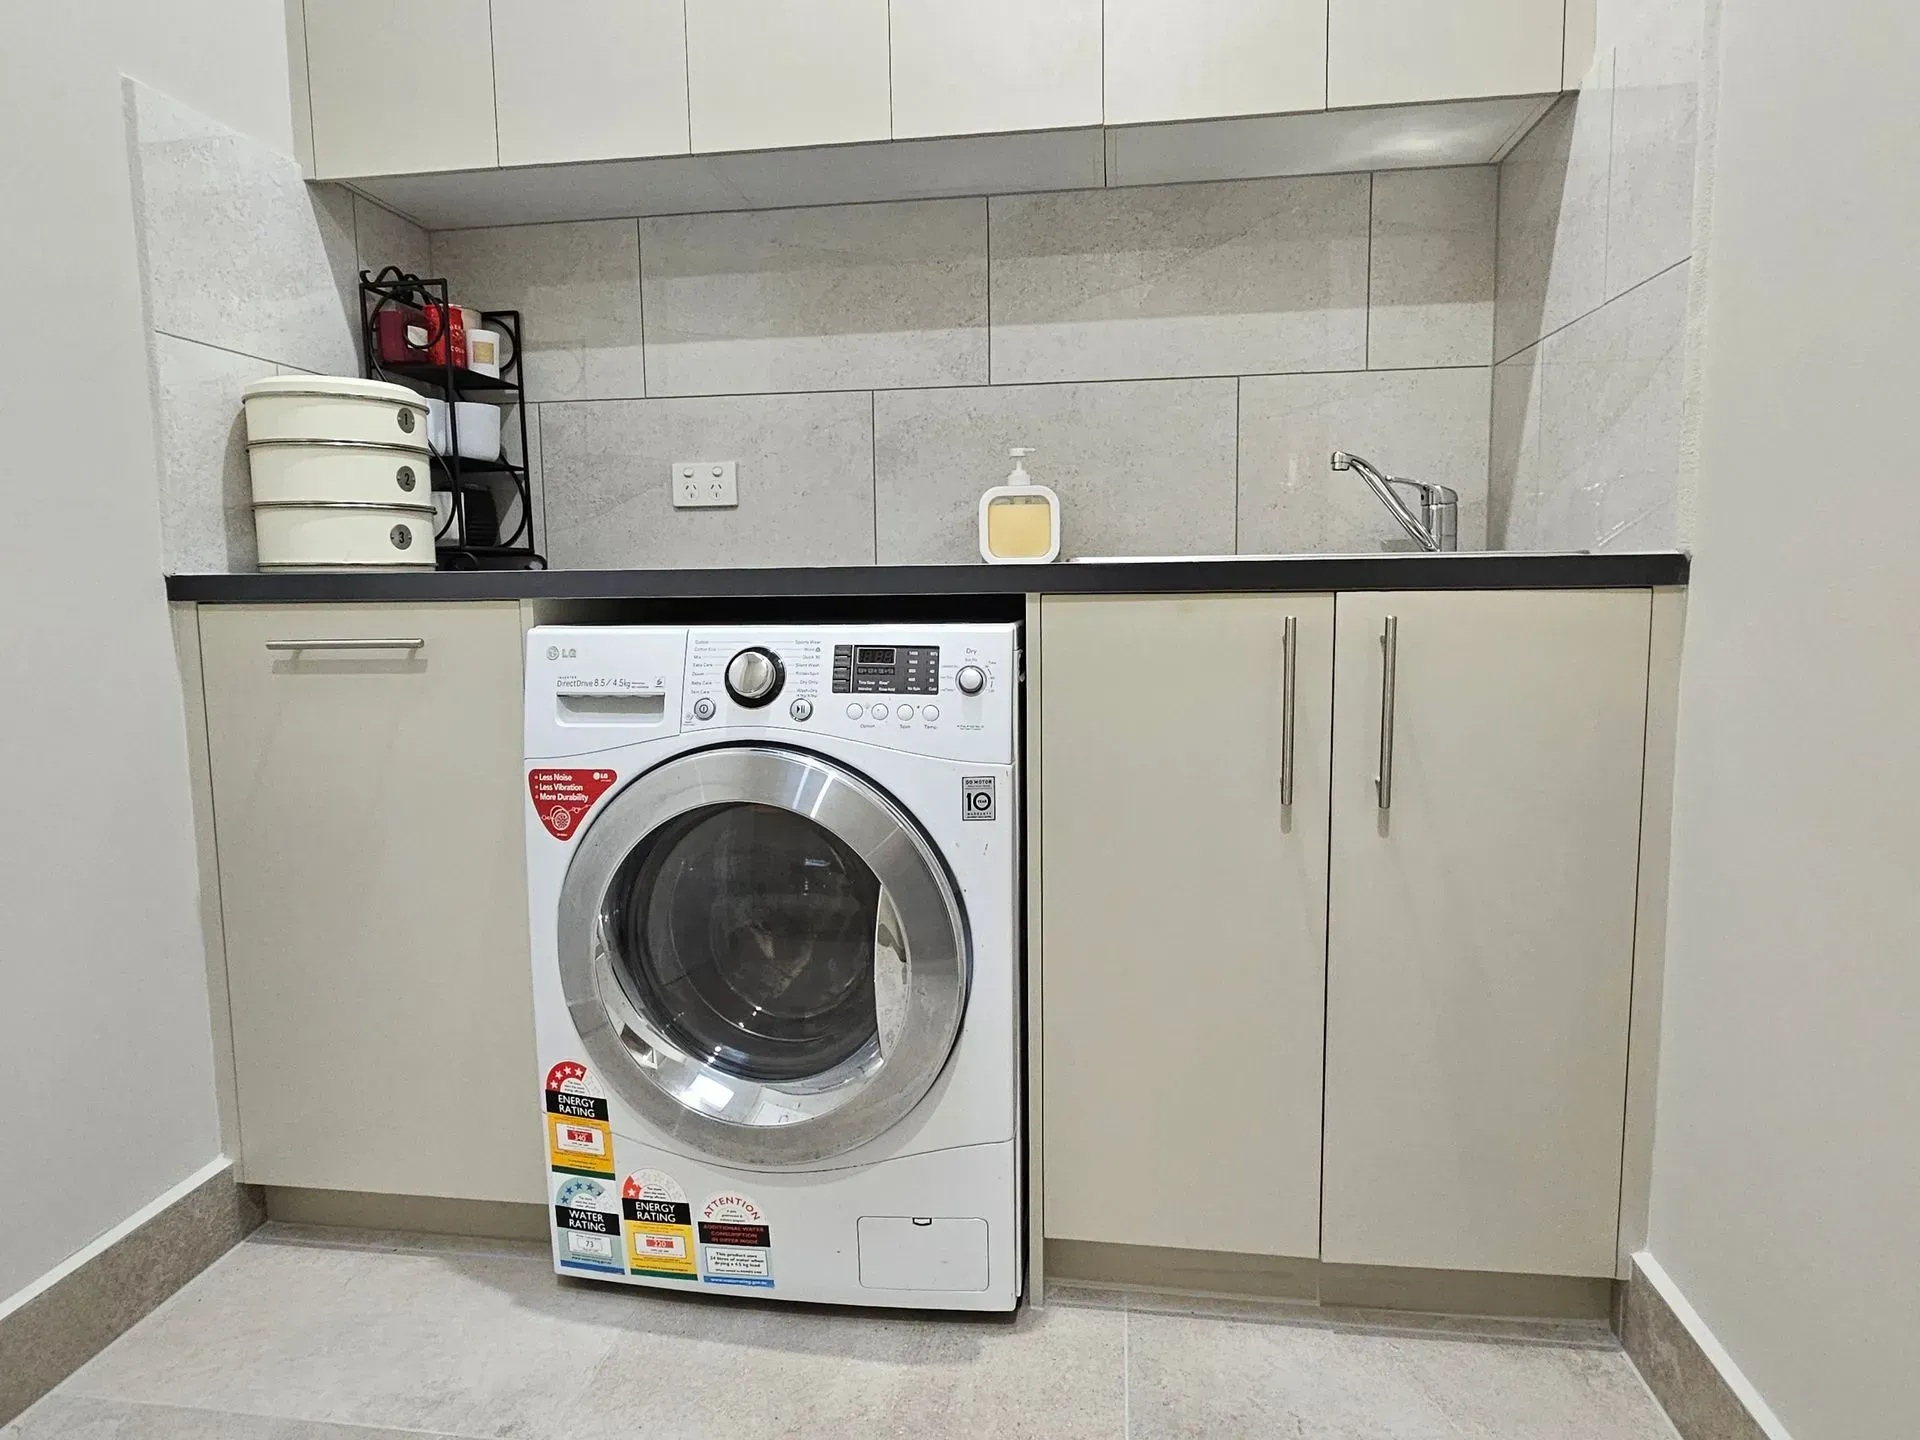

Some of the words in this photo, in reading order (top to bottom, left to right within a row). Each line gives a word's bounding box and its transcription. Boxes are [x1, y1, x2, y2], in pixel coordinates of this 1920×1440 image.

[404, 472, 410, 486] 2
[398, 530, 405, 544] 3
[539, 773, 553, 781] Less
[553, 773, 573, 781] Noise
[539, 783, 553, 791] Less
[554, 783, 584, 792] Vibration
[539, 793, 557, 801] More
[557, 793, 589, 804] Durability
[966, 792, 992, 811] 10
[558, 1094, 595, 1109] ENERGY
[559, 1104, 595, 1118] RATING
[635, 1201, 676, 1213] ENERGY
[704, 1196, 761, 1221] ATTENTION
[568, 1209, 604, 1223] WATER
[636, 1211, 677, 1223] RATING
[568, 1219, 607, 1233] RATING
[703, 1223, 741, 1231] ADDITIONAL
